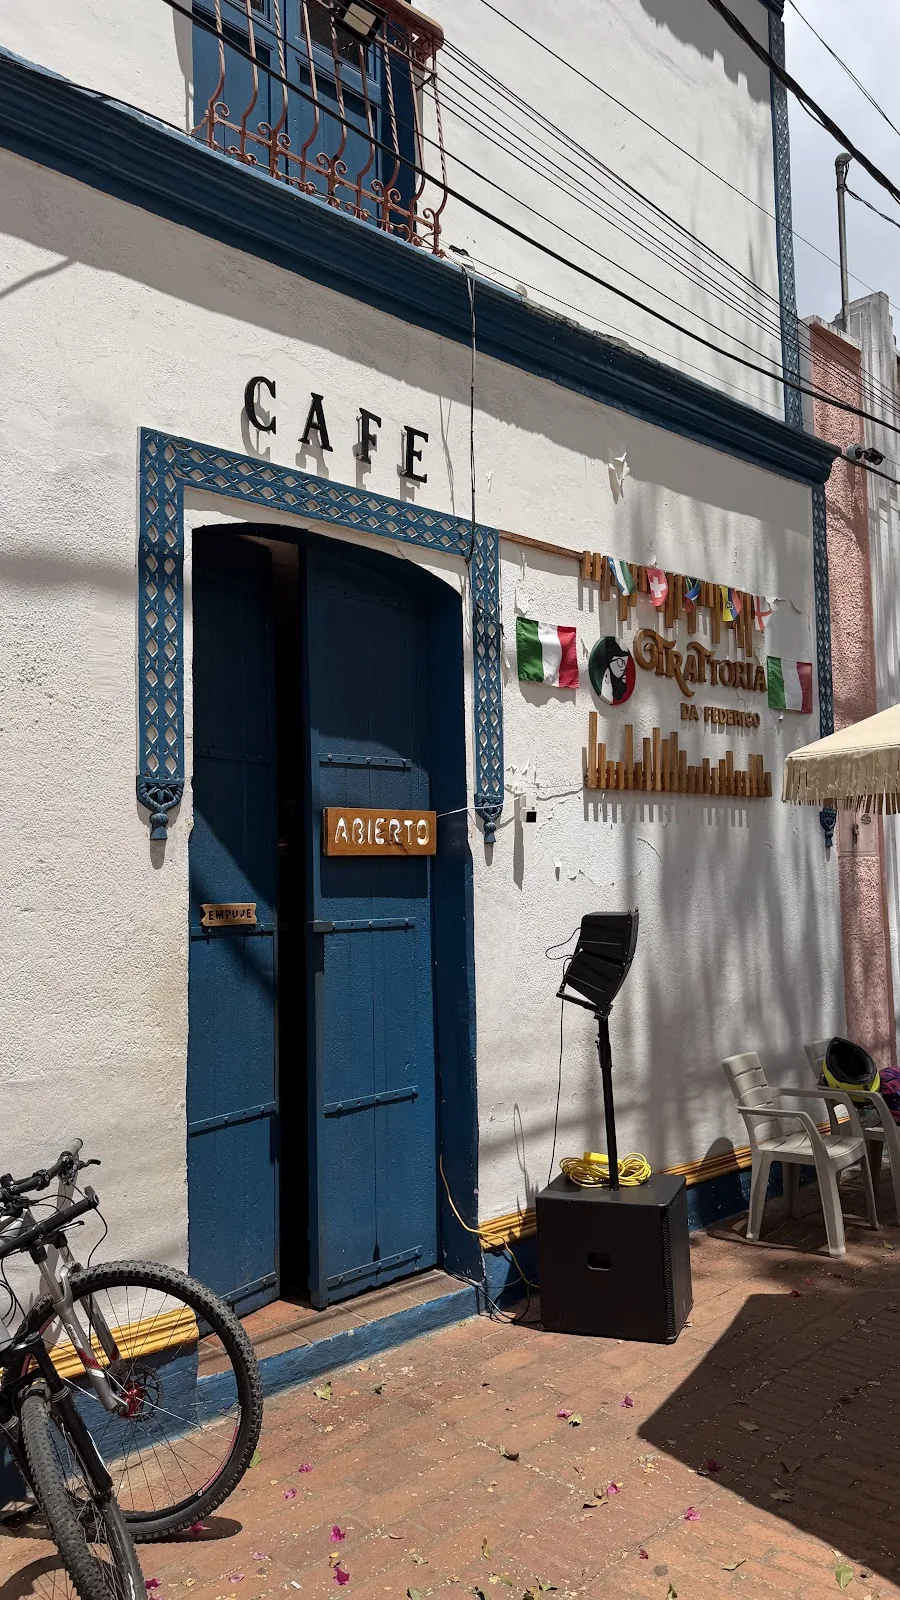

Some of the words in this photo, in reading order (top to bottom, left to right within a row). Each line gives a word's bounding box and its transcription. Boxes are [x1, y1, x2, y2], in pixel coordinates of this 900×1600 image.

[244, 375, 429, 483] CAFE
[633, 628, 768, 697] TRATTORIA
[680, 702, 700, 721] DA
[334, 817, 430, 846] ABIERTO
[208, 908, 253, 920] EMPUJE
